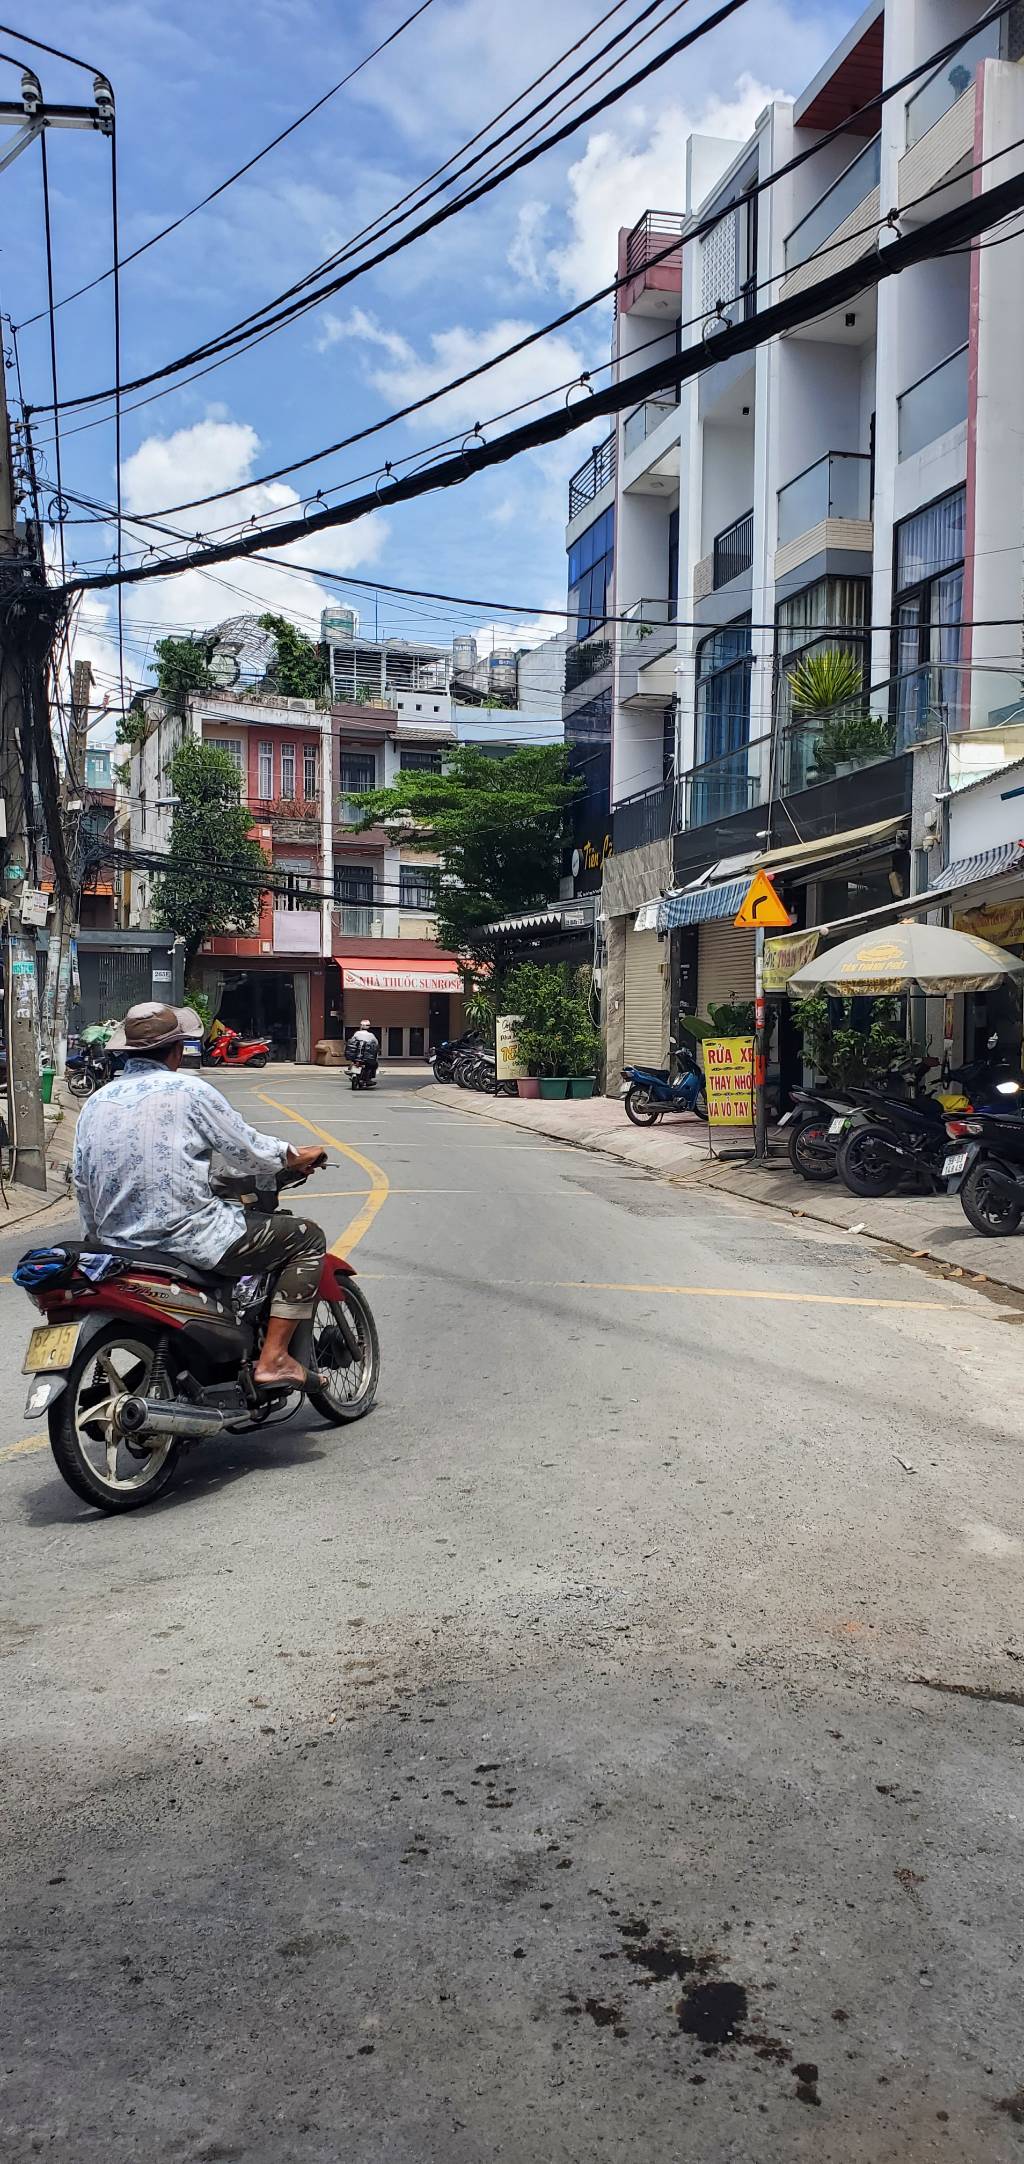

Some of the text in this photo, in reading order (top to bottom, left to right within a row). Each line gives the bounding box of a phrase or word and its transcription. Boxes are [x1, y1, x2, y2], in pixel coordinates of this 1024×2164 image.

[360, 973, 462, 990] NHÀ THUỐC SUNROSE
[708, 1043, 733, 1064] RỬA
[709, 1074, 732, 1091] THAY
[709, 1099, 719, 1117] VÁ
[721, 1096, 732, 1116] VỎ
[734, 1101, 749, 1117] TAY
